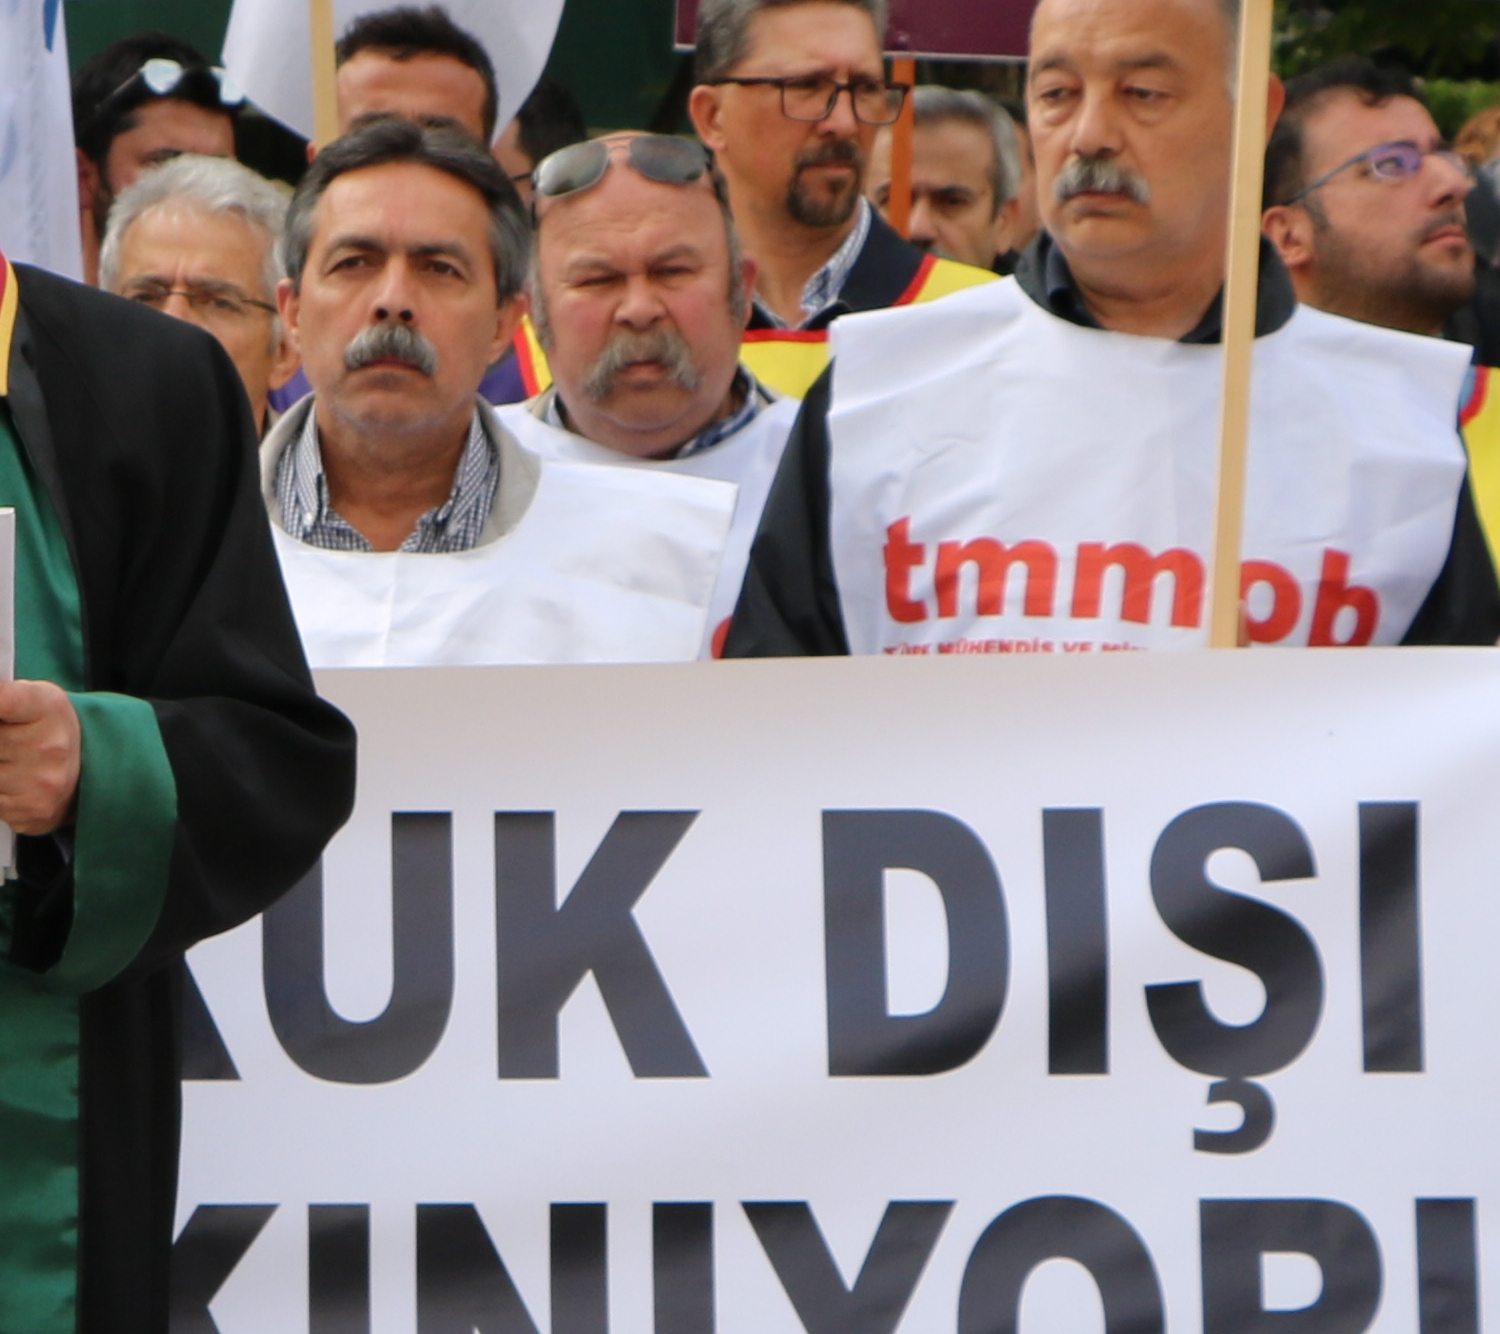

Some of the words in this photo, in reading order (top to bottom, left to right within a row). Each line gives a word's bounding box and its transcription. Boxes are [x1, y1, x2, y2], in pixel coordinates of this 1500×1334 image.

[883, 515, 1381, 648] tmmob
[182, 809, 710, 1086] UK
[820, 801, 1427, 1155] DIŞI
